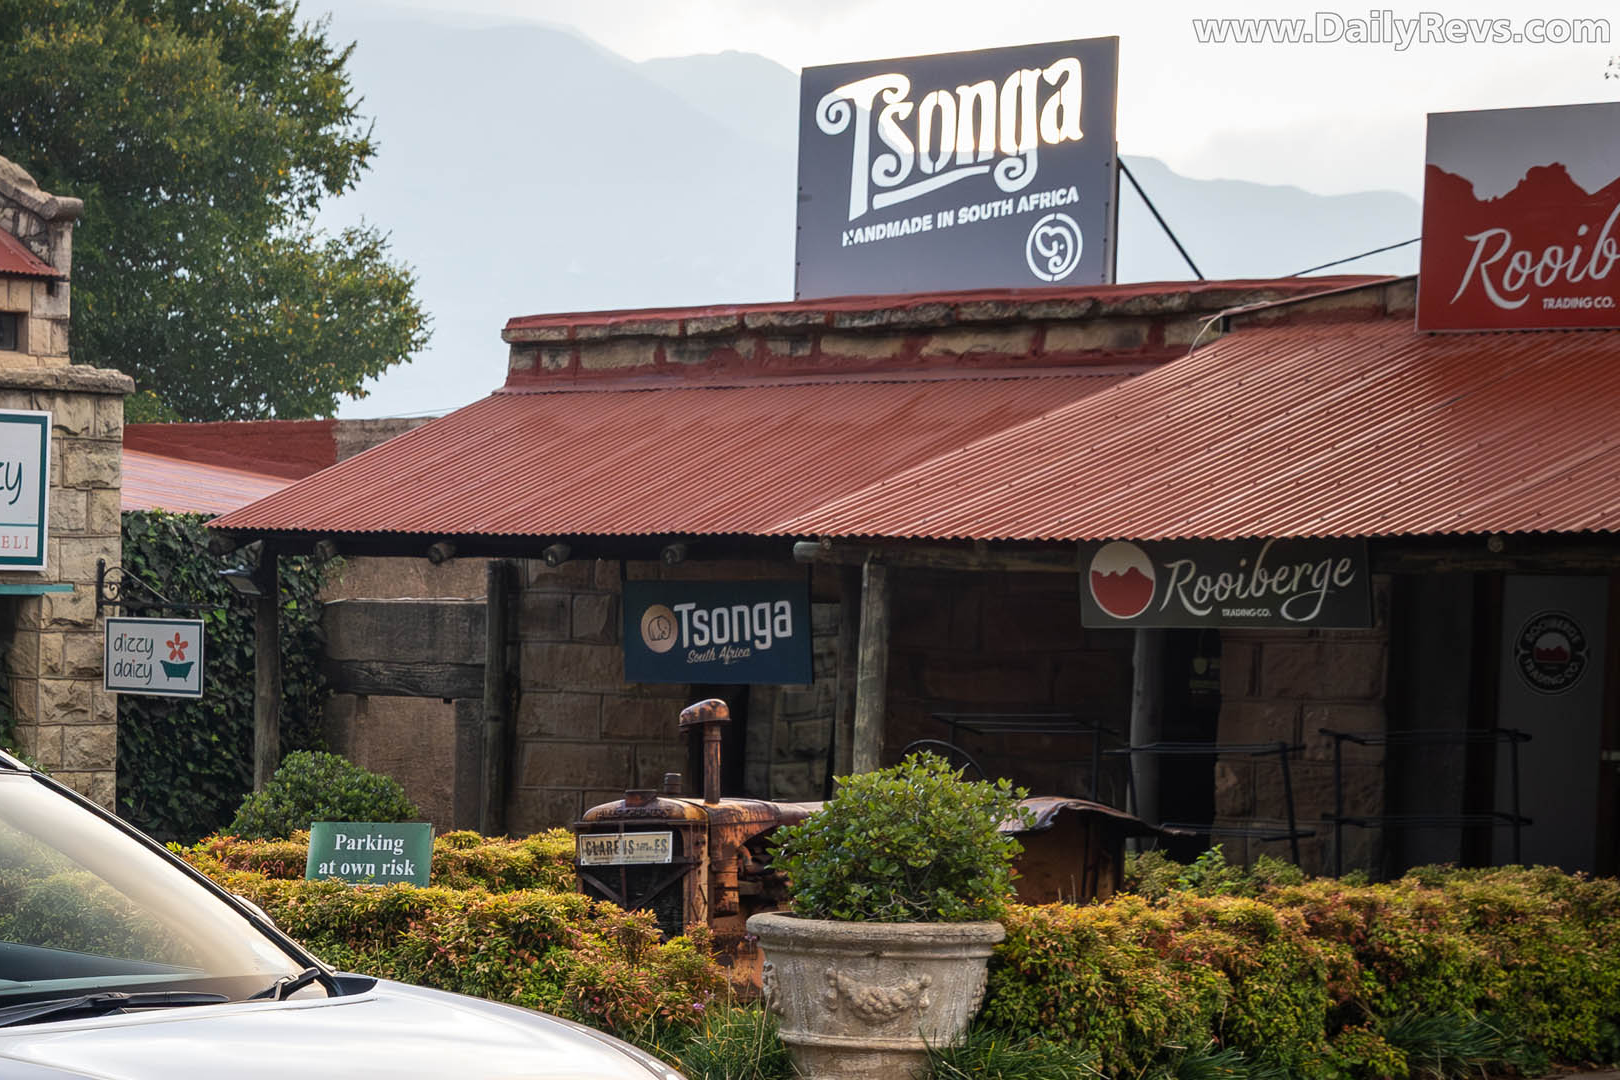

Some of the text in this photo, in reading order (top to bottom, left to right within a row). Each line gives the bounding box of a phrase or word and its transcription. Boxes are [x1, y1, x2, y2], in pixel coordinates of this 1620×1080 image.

[816, 57, 1084, 222] Tsonga
[842, 186, 1080, 247] HANDMADE IN SOUTH AFRICA
[1542, 296, 1616, 309] TRADING CO.
[1159, 538, 1356, 622] Rooiberge
[673, 600, 793, 650] Tsonga
[113, 633, 154, 660] dizzy
[686, 645, 751, 665] South Africa
[113, 659, 152, 685] daizy
[334, 833, 405, 855] Parking
[318, 859, 416, 876] at own risk
